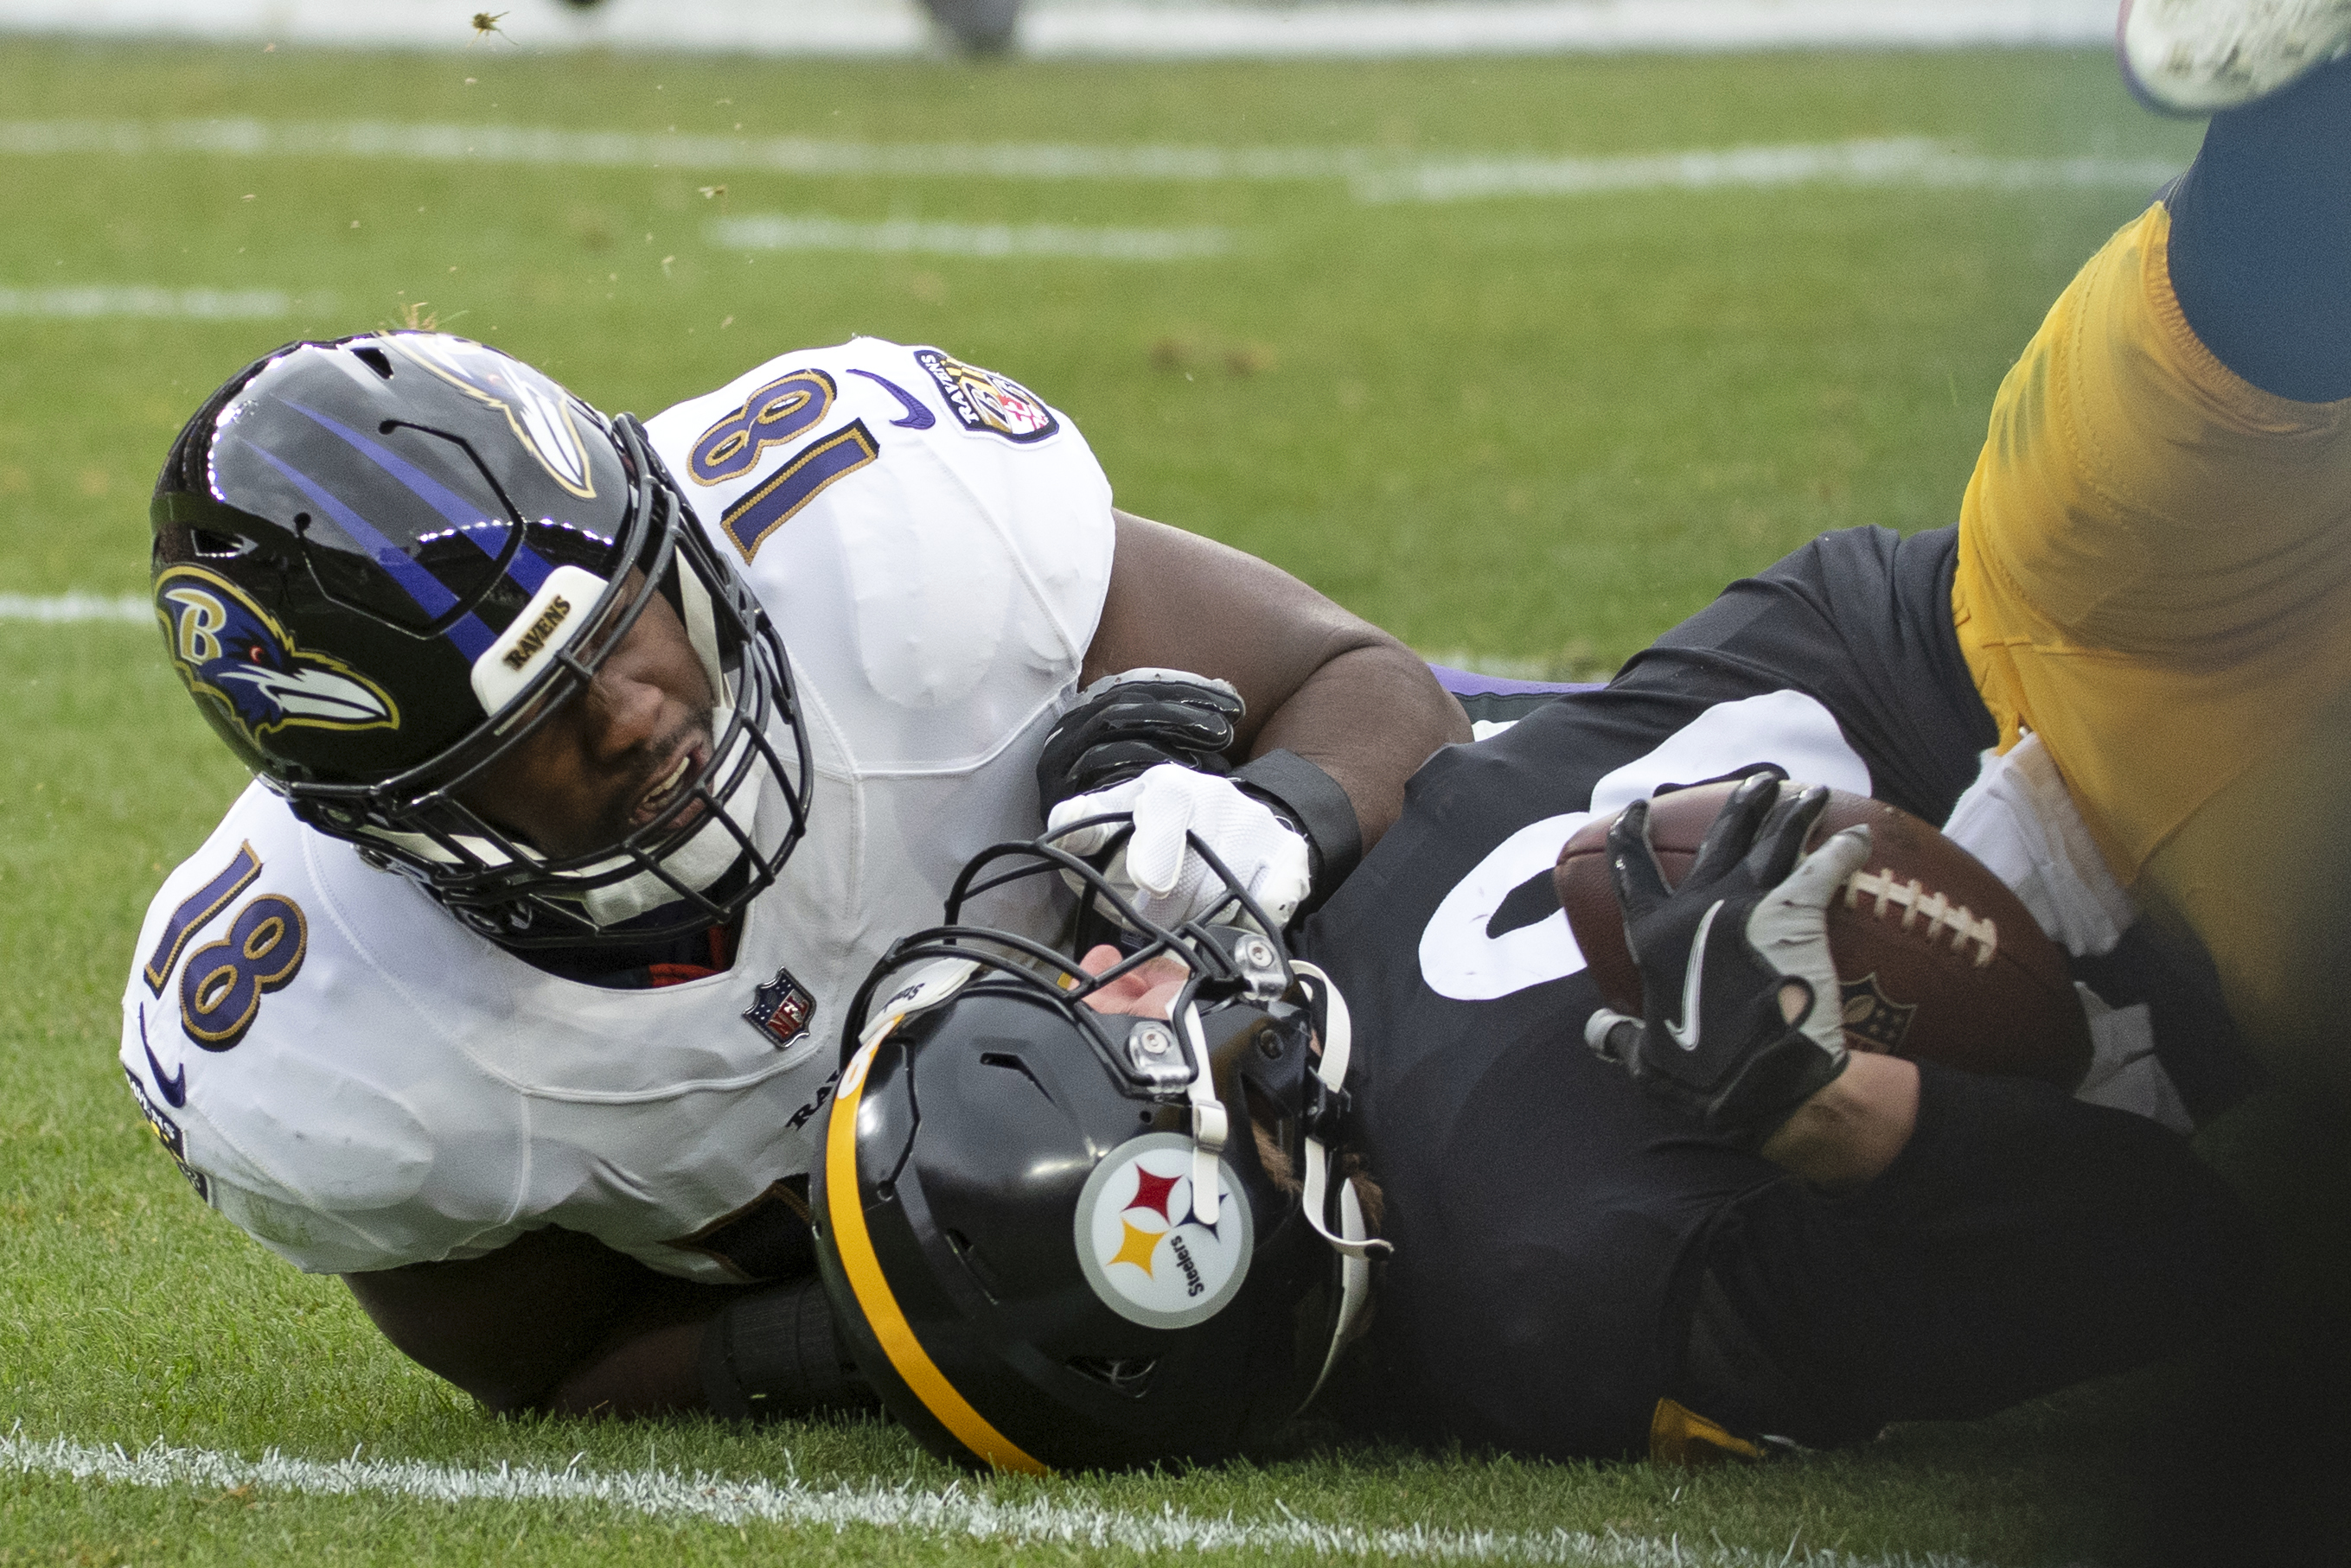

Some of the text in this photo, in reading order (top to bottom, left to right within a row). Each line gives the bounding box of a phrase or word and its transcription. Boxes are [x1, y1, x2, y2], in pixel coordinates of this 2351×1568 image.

[921, 354, 980, 425] RAVENS
[687, 368, 880, 566] 18
[165, 588, 227, 666] B
[502, 593, 571, 672] RAVENS
[144, 838, 308, 1052] 18
[766, 993, 810, 1039] NFL
[1171, 1235, 1204, 1297] Steelers
